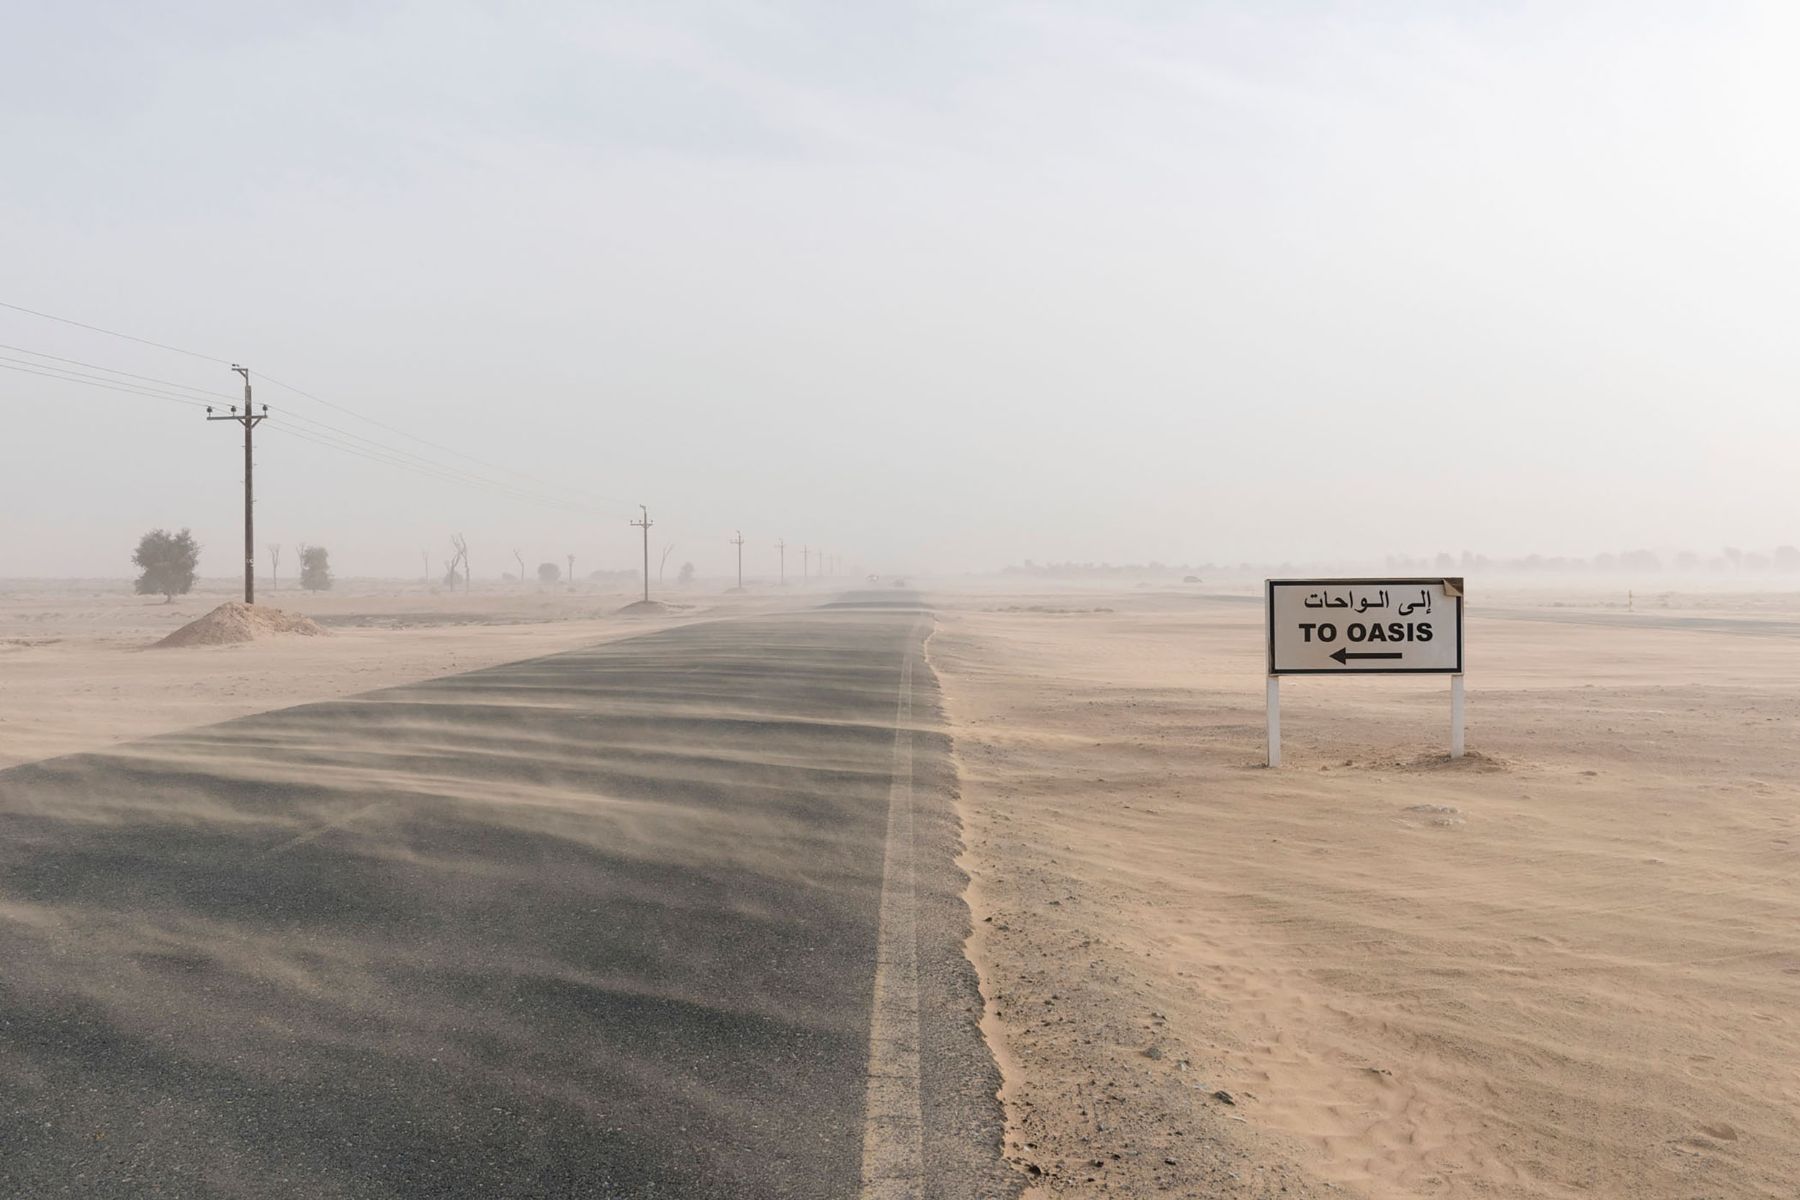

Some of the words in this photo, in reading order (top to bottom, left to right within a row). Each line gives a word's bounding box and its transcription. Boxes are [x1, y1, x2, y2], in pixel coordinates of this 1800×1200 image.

[1304, 590, 1389, 613] الواحات
[1398, 590, 1432, 615] إلى
[1298, 623, 1338, 643] TO
[1346, 622, 1434, 643] OASIS
